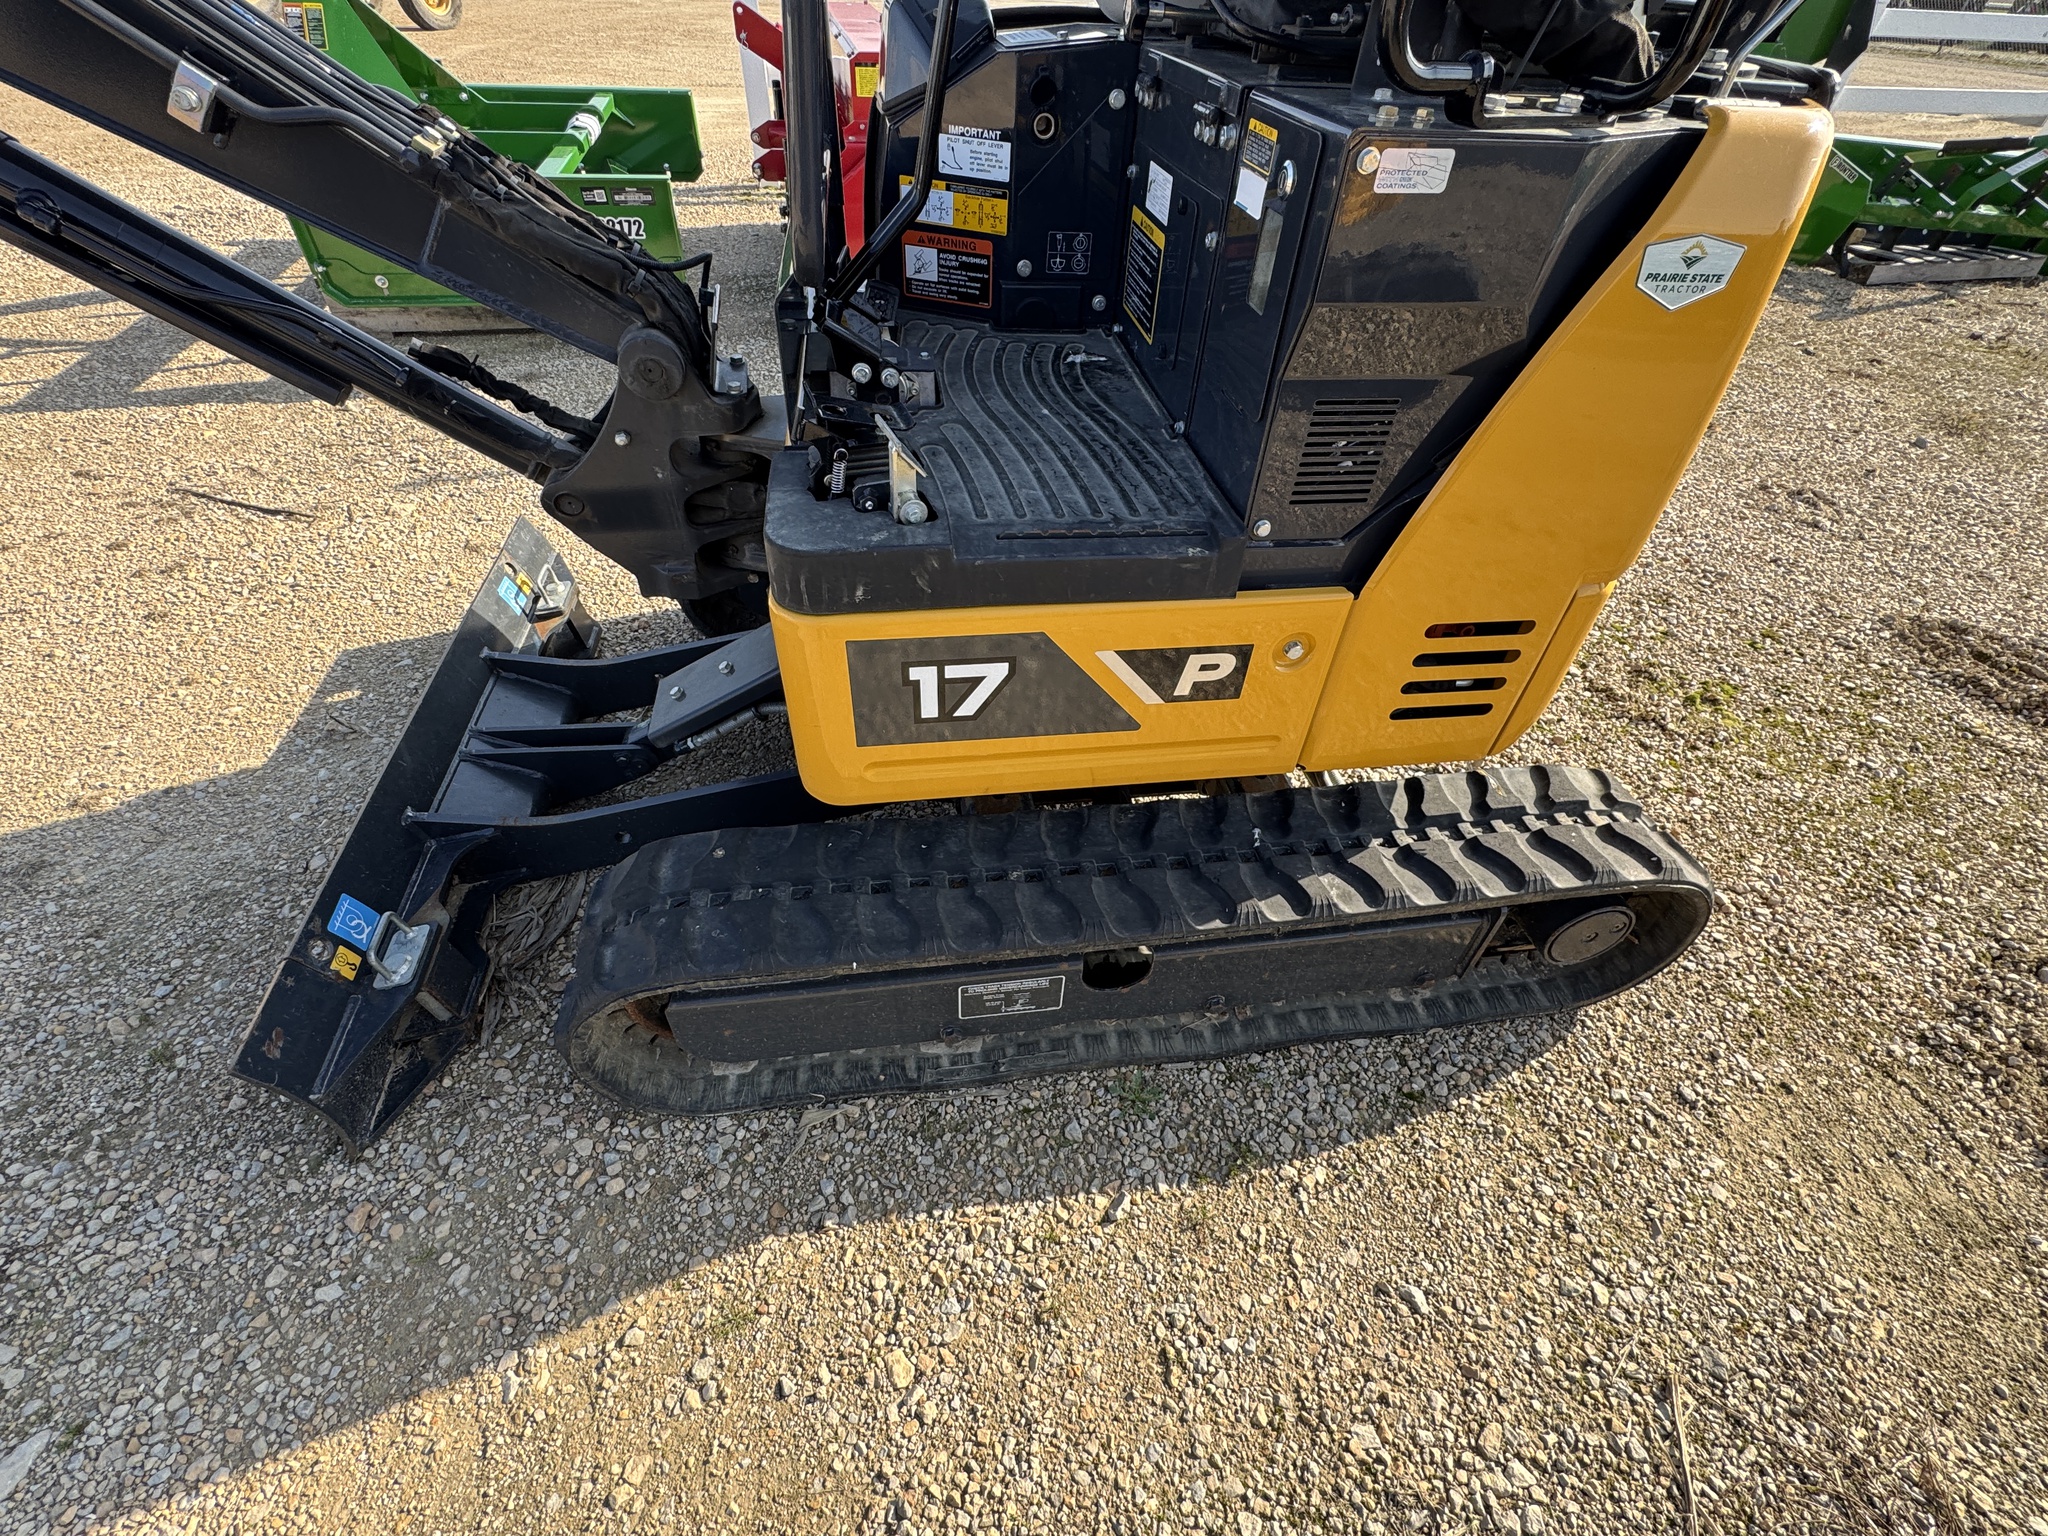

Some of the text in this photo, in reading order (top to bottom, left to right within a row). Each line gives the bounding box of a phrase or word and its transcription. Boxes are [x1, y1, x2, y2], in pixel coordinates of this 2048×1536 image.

[948, 124, 1002, 140] IMPORTANT
[988, 142, 1004, 150] LEVER
[926, 235, 977, 251] WARNING
[939, 260, 960, 268] INJURY
[958, 255, 988, 265] CRUSHING
[1644, 273, 1725, 284] PRAIRIE STATE
[1655, 284, 1707, 294] TRACTOR
[1173, 653, 1236, 696] P
[909, 662, 1009, 718] 17
